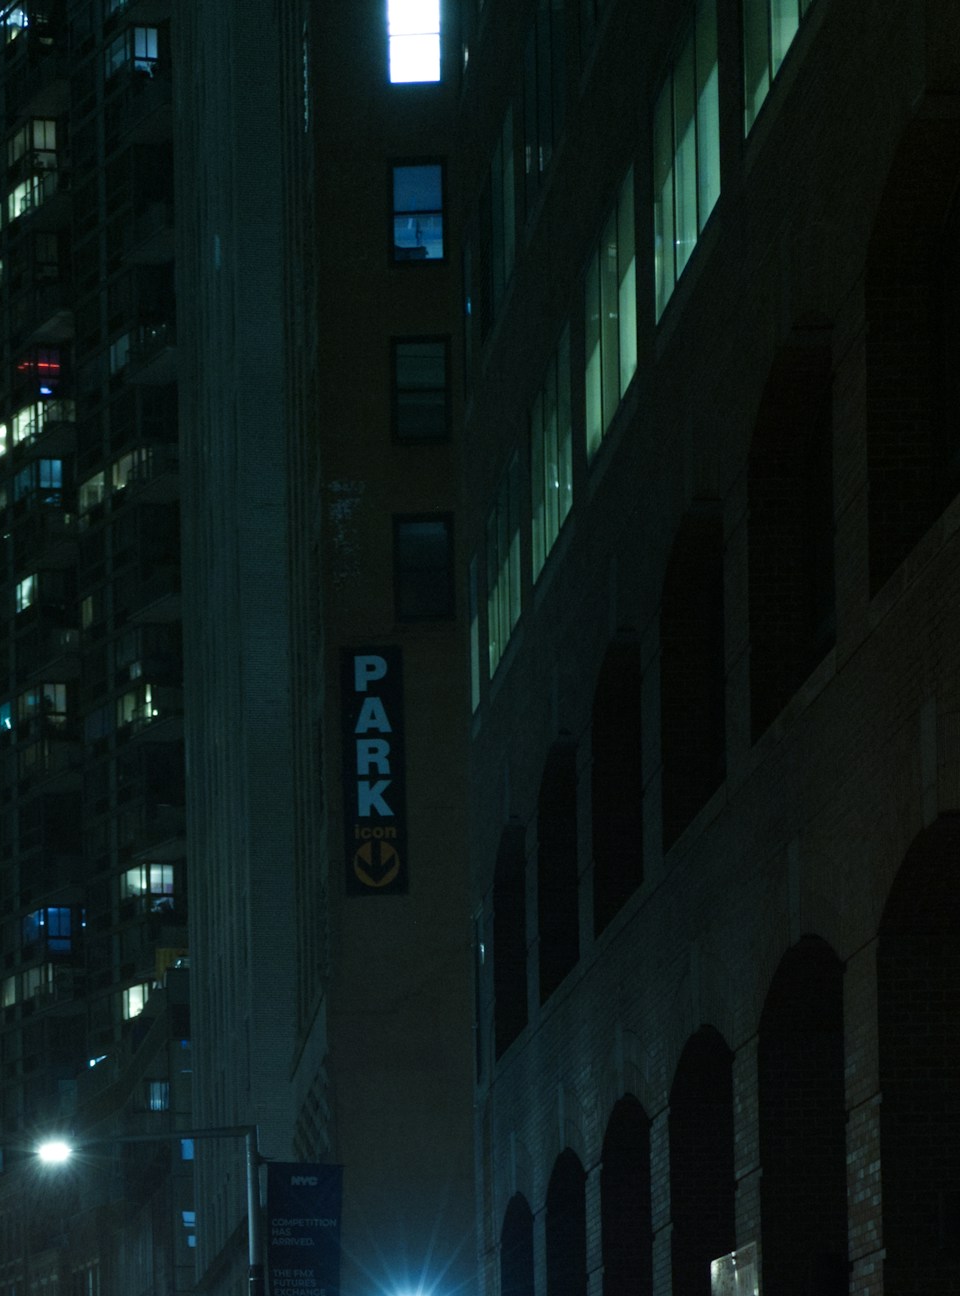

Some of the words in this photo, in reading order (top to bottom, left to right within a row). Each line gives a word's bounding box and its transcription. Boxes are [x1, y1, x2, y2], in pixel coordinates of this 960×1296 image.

[353, 655, 395, 817] PARK
[354, 824, 397, 840] icon
[291, 1175, 319, 1186] NYC
[271, 1218, 337, 1227] COMPETITION
[271, 1227, 292, 1237] HAS
[272, 1269, 292, 1278] THE
[273, 1279, 317, 1288] FUTURES
[274, 1288, 326, 1296] EXCHANGE
